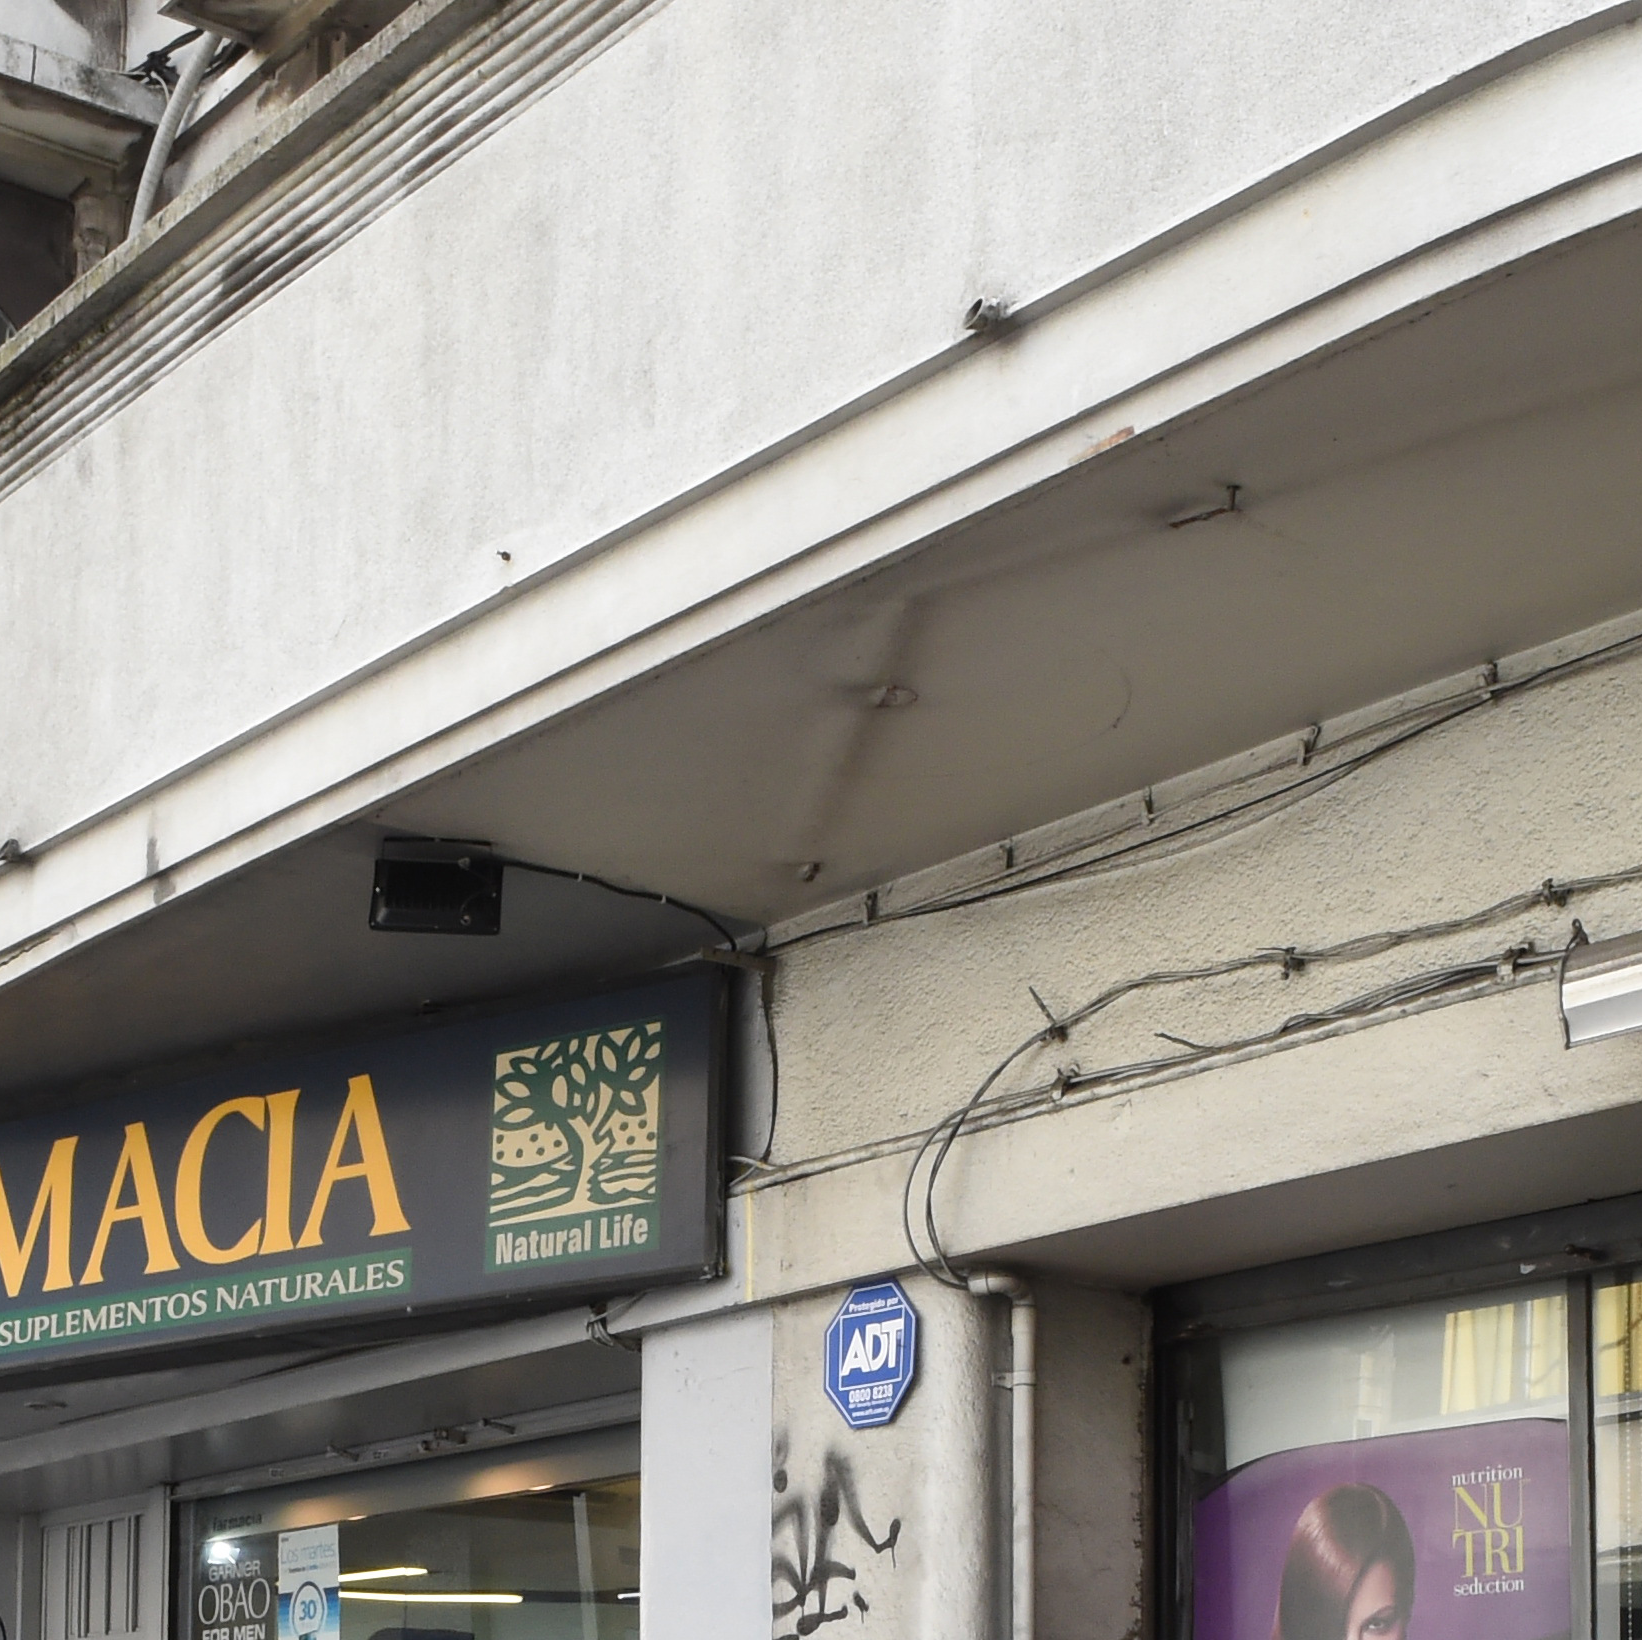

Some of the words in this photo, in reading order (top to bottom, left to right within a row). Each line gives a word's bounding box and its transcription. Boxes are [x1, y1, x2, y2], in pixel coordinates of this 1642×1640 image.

[495, 1219, 592, 1265] Natural
[599, 1213, 649, 1249] Life
[214, 1259, 406, 1313] NATURALES
[848, 1297, 885, 1314] Protegido
[886, 1296, 899, 1308] por
[841, 1318, 903, 1376] ADT
[1451, 1464, 1523, 1487] nutrition
[1451, 1479, 1525, 1534] NU
[1451, 1524, 1525, 1578] TRI
[198, 1578, 271, 1625] OBAO
[299, 1600, 317, 1621] 30
[1453, 1576, 1525, 1597] seduction
